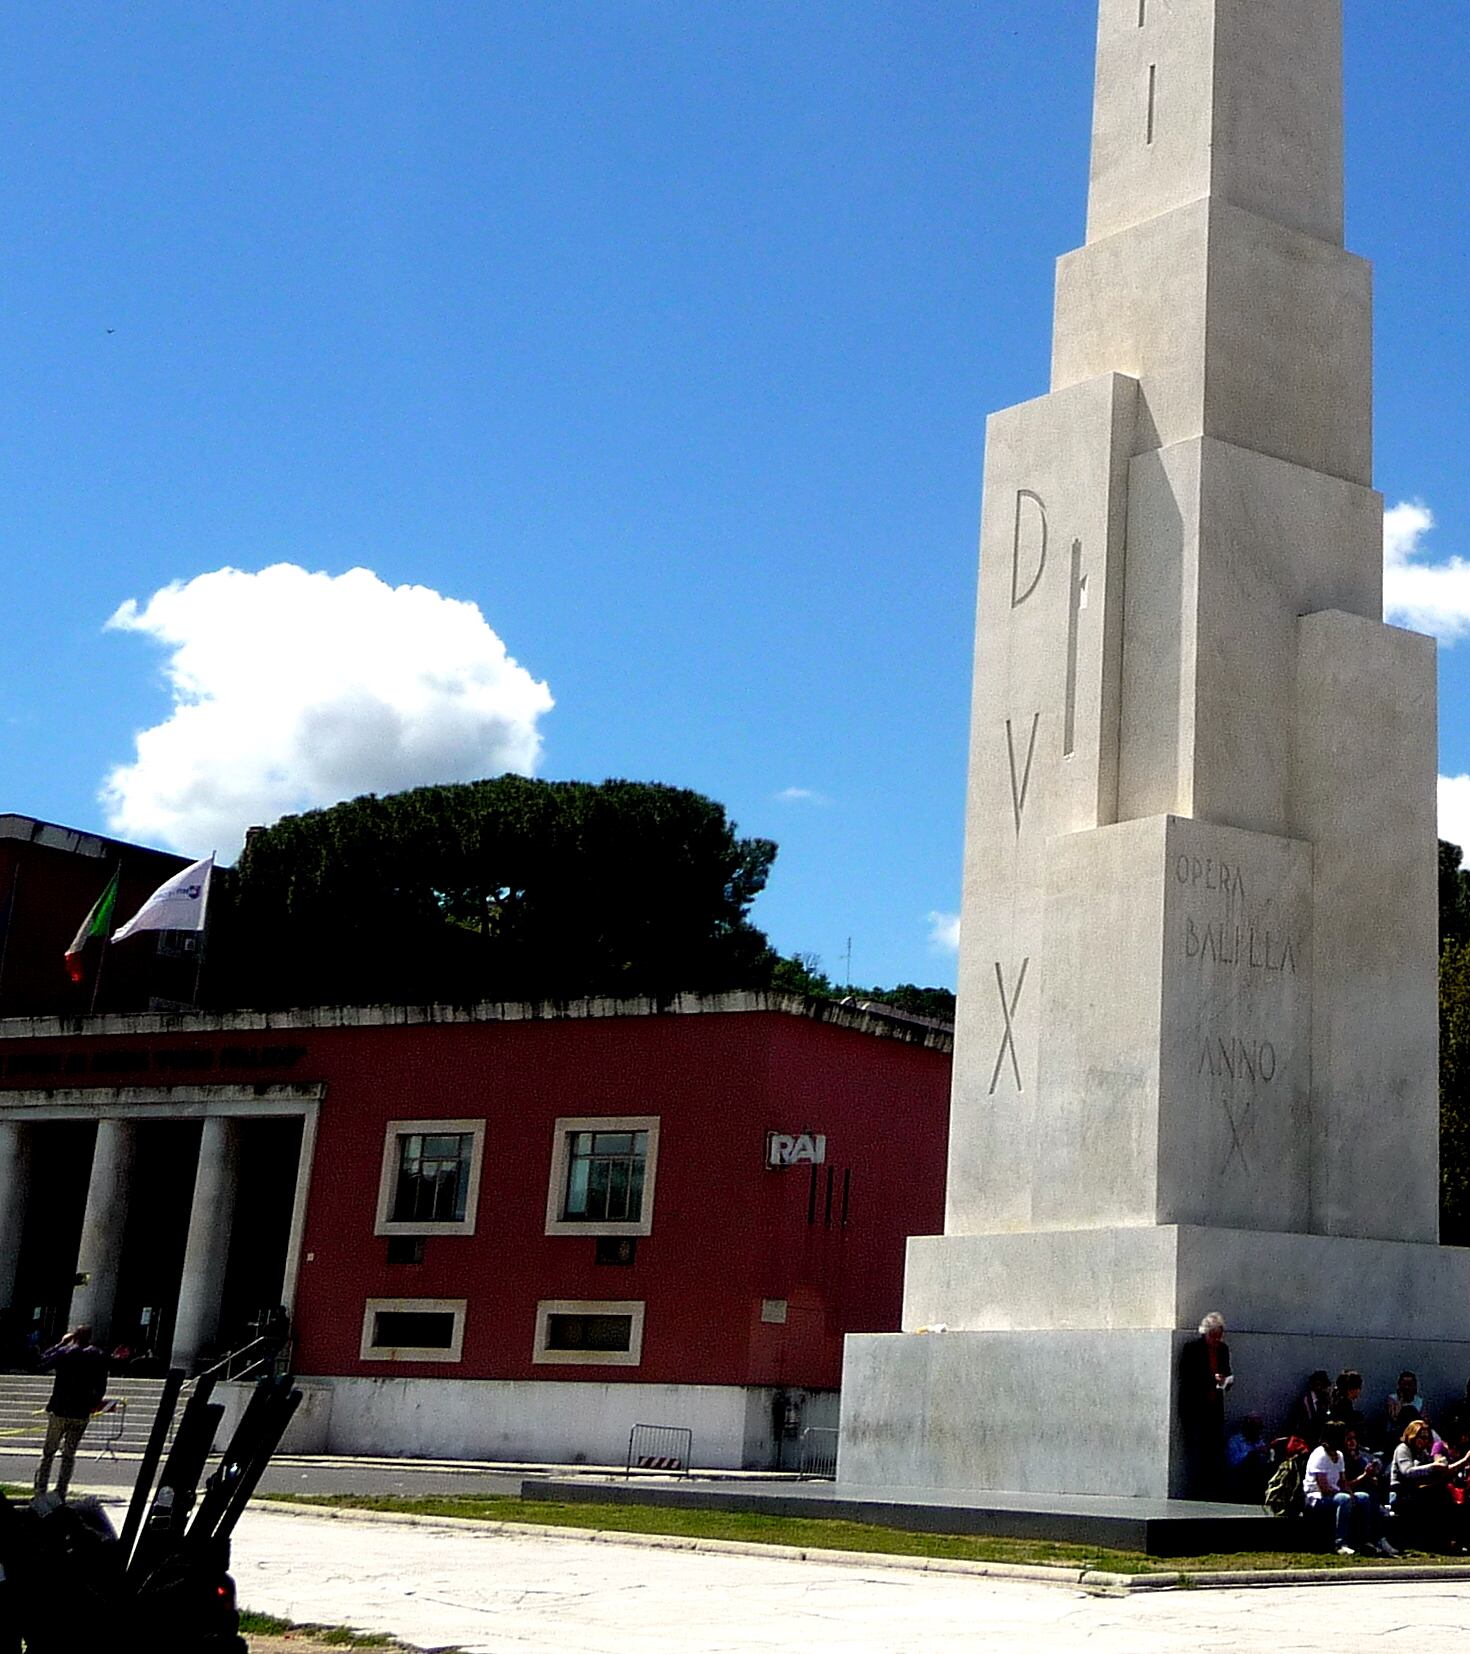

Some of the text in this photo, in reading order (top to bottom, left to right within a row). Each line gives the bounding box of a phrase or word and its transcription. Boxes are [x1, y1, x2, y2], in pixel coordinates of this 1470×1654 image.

[1175, 854, 1245, 902] OPERA
[1184, 916, 1297, 976] BALILLA
[1197, 1036, 1276, 1083] ANNO
[769, 1133, 827, 1166] RAI
[1219, 1099, 1251, 1177] X
